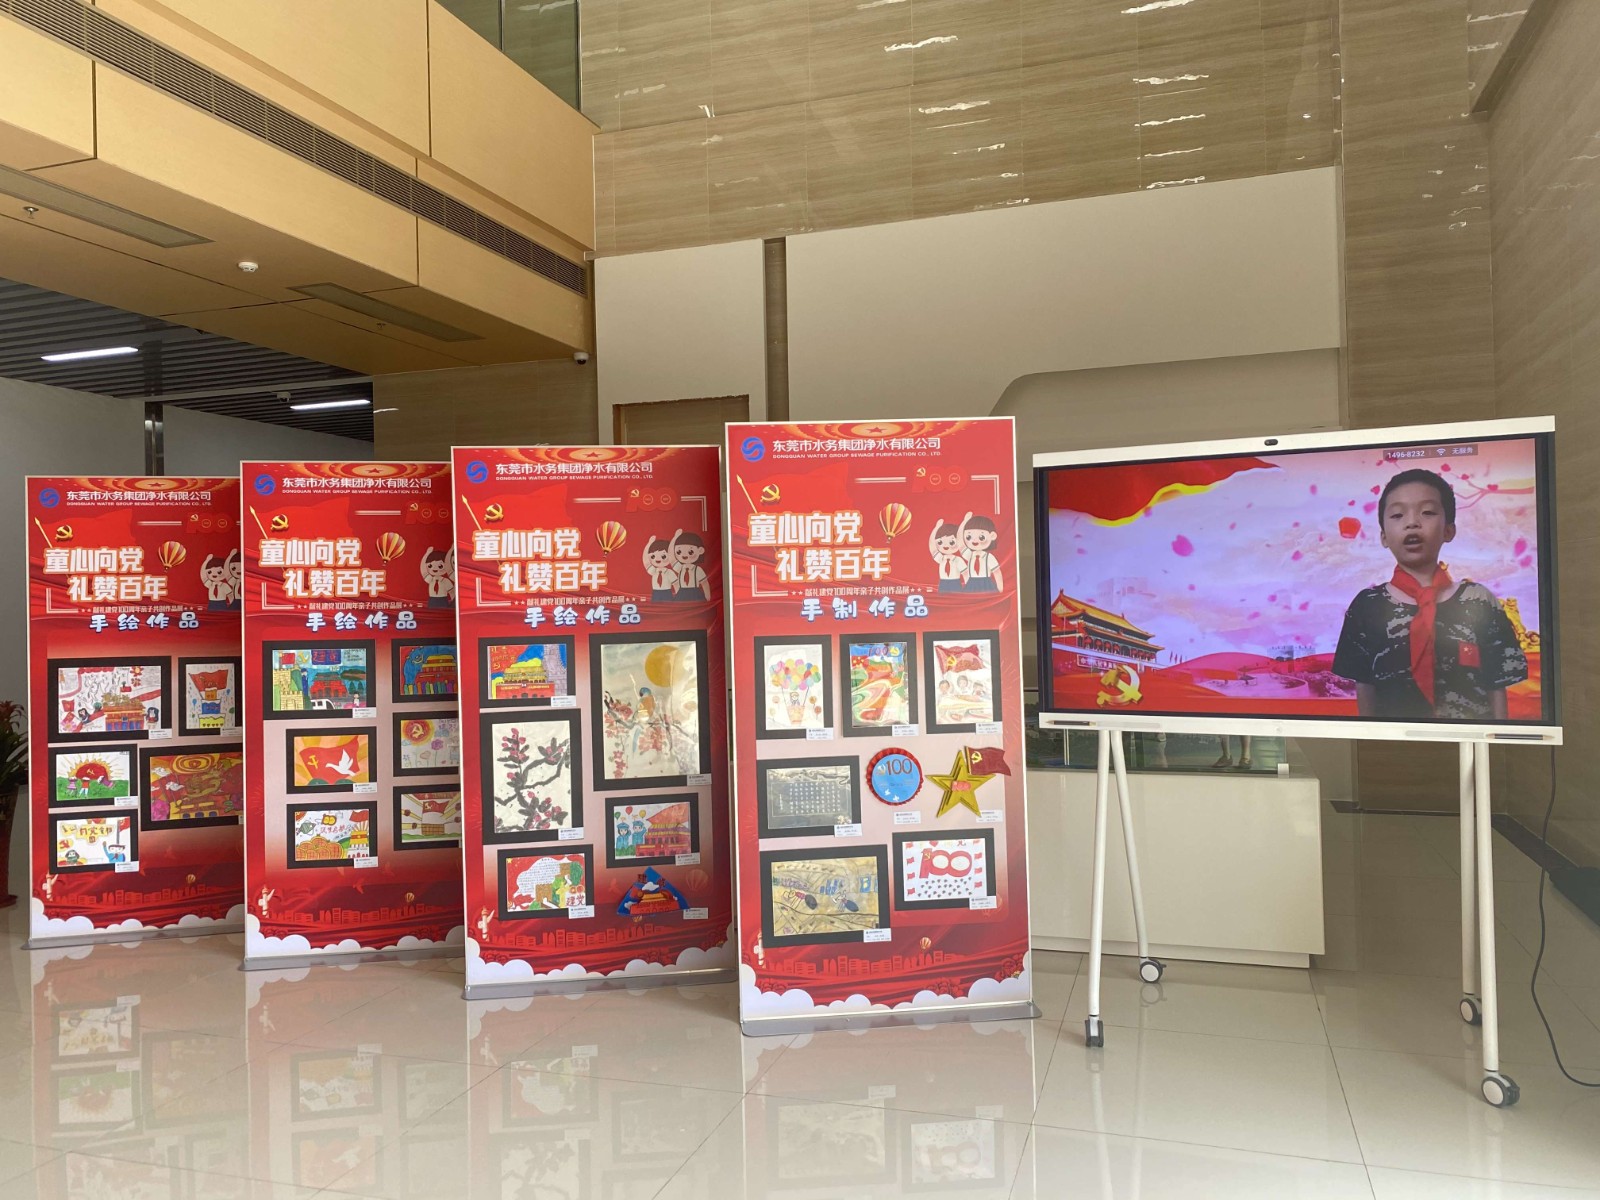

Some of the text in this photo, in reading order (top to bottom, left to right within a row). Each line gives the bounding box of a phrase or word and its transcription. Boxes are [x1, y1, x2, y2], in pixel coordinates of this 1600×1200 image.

[772, 438, 941, 452] 东莞市水务集团净水有限公司
[1387, 450, 1425, 458] 1496-8232
[1451, 447, 1474, 455] 无服务
[495, 462, 653, 475] 东莞市水务集团净水有限公司
[281, 477, 432, 489] 东莞市水务集团净水有限公司
[66, 490, 211, 501] 东莞市水务集团净水有限公司
[749, 513, 862, 545] 童心向党
[260, 539, 361, 566] 童心向党
[473, 529, 580, 559] 童心向党
[45, 547, 143, 573] 童心向党
[777, 548, 890, 581] 礼赞百年
[68, 575, 168, 601] 礼赞百年
[285, 569, 386, 597] 礼赞百年
[500, 562, 607, 592] 礼赞百年
[524, 604, 640, 628] 手绘作品
[801, 595, 928, 622] 手制作品
[89, 612, 199, 633] 手绘作品
[306, 611, 417, 632] 手绘作品
[886, 757, 913, 776] 100
